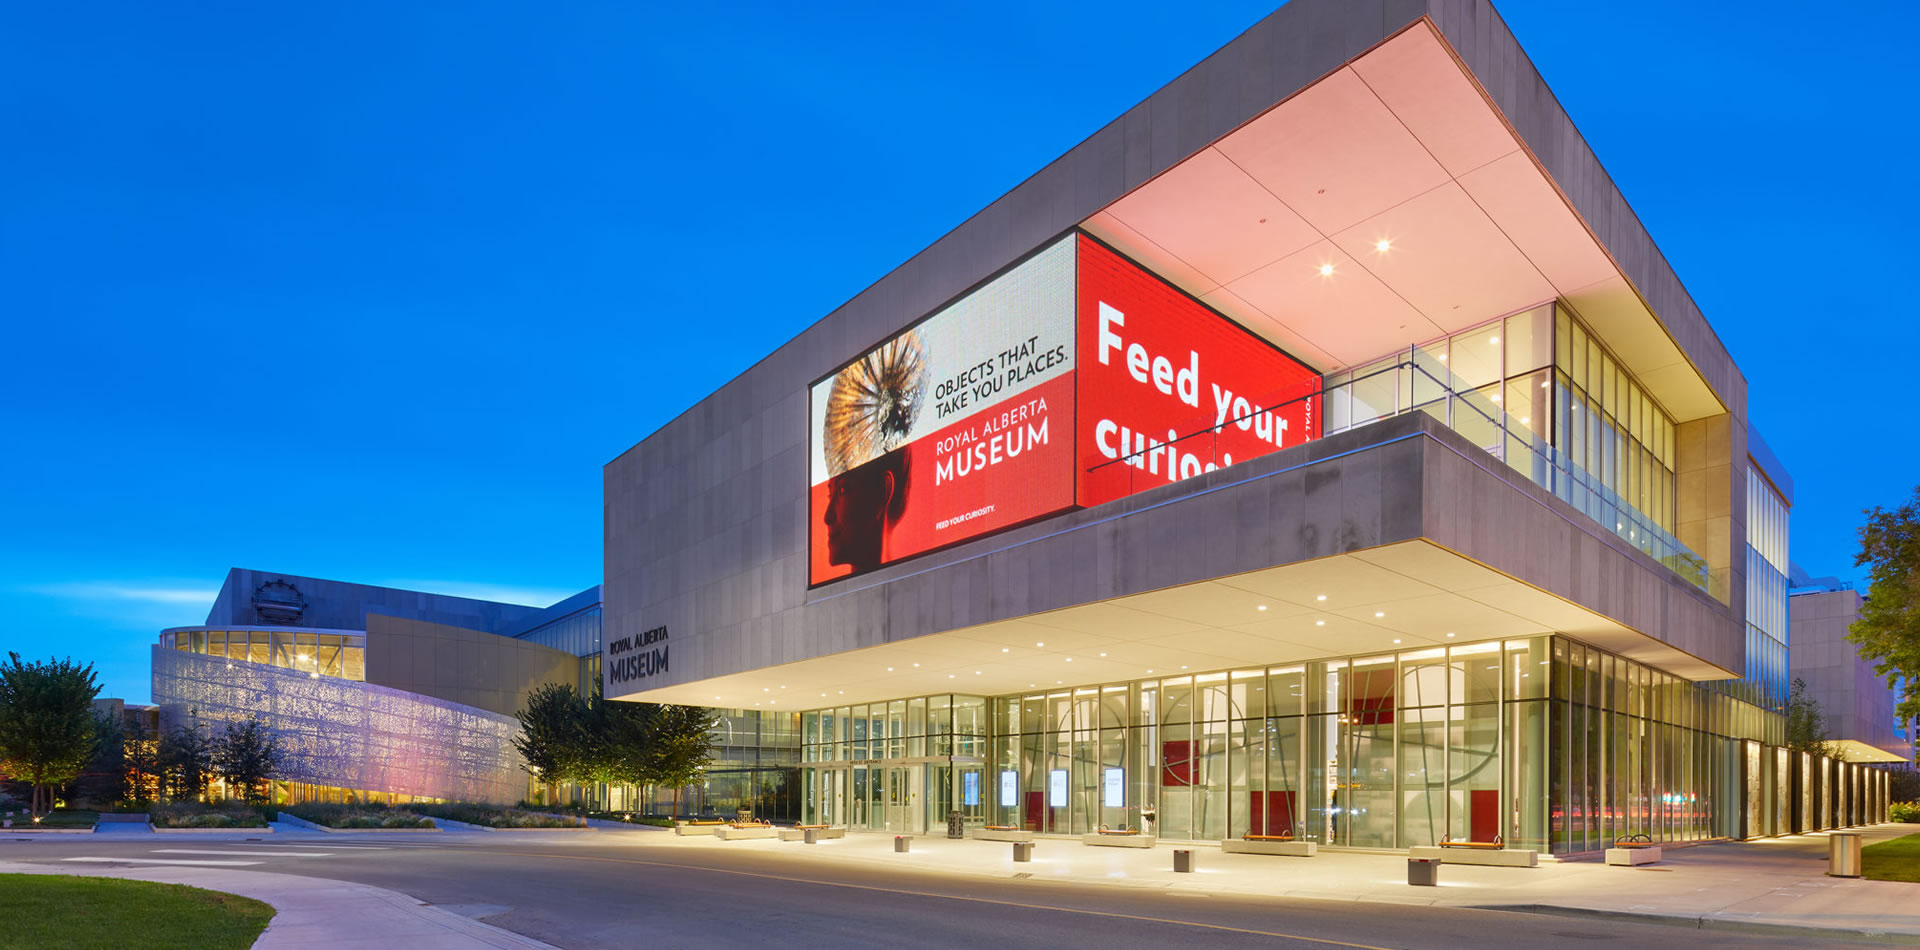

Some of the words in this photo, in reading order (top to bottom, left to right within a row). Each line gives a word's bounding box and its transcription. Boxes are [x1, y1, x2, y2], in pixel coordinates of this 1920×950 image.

[935, 358, 994, 400] OBJECTS
[998, 335, 1039, 369] THAT
[935, 391, 968, 419] TAKE
[972, 374, 1003, 402] YOU
[1007, 345, 1069, 387] PLACES.
[1098, 300, 1199, 409] Feed
[1211, 382, 1288, 448] your
[935, 415, 1049, 487] MUSEUM
[936, 426, 978, 456] ROYAL
[983, 397, 1048, 437] ALBERTA
[1095, 418, 1232, 482] curio
[935, 519, 950, 531] FEED
[950, 514, 965, 526] YOUR
[610, 637, 633, 655] ROYAL
[634, 625, 669, 648] ALBERTA
[610, 645, 669, 685] MUSEUM
